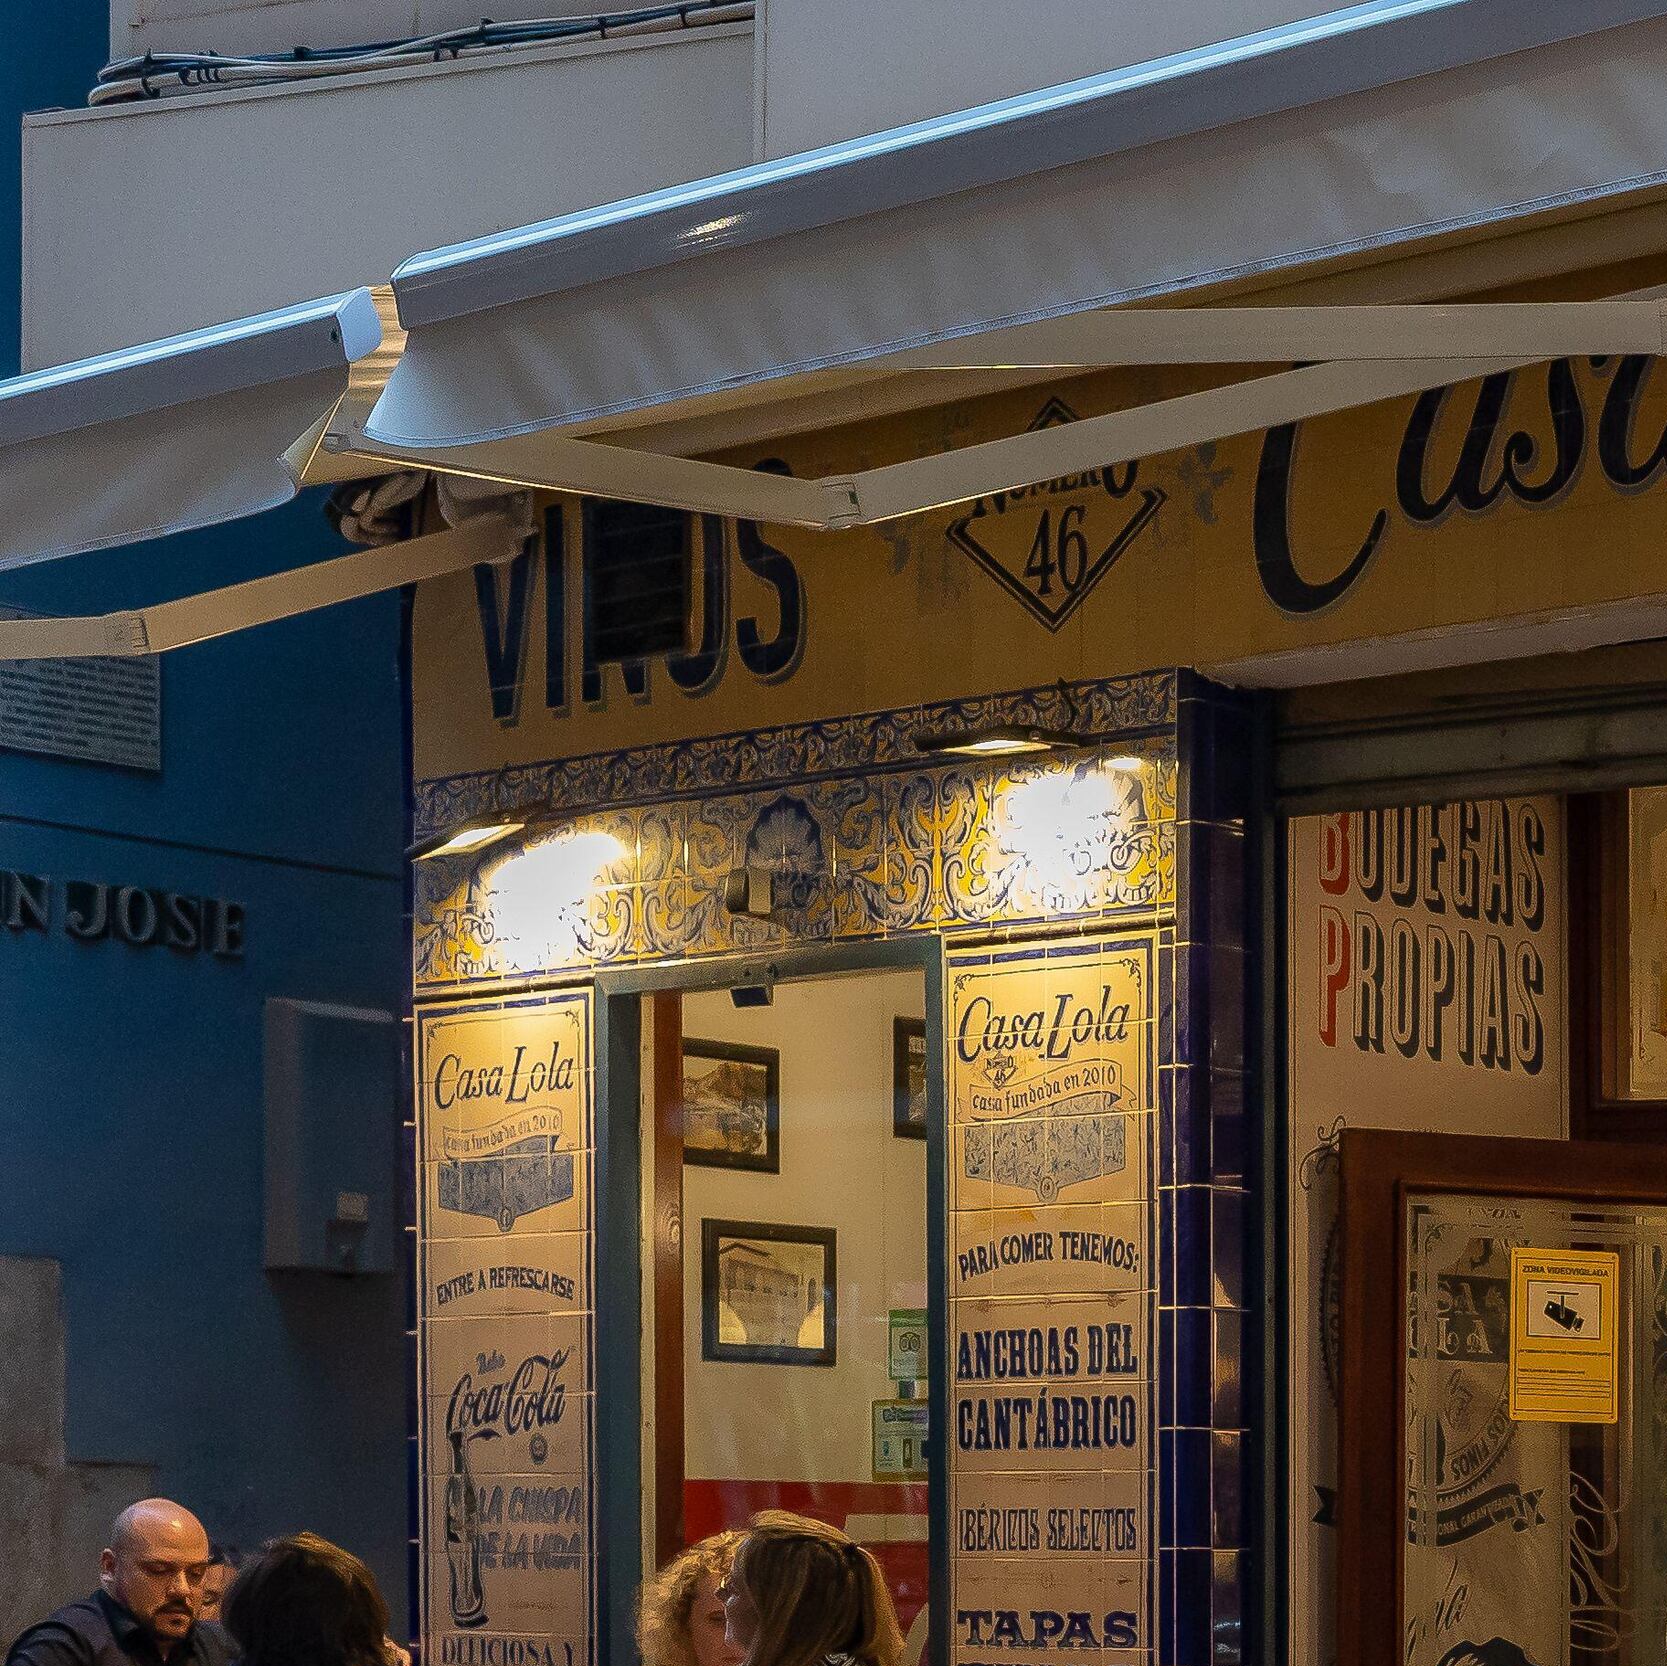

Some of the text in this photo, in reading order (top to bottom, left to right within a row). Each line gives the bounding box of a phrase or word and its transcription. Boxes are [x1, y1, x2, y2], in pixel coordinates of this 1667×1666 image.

[1023, 505, 1090, 597] 46
[65, 880, 248, 962] JOSE
[1318, 904, 1546, 1076] PROPIAS
[958, 985, 1131, 1063] Casa Lola
[434, 1041, 574, 1110] Casa Lola
[1083, 1063, 1116, 1089] 2010
[437, 1266, 575, 1305] ENTRE A REFRESCARSE
[958, 1231, 1140, 1282] PARA COMER TENEMOS:
[957, 1323, 1138, 1379] ANCHOAS DEL
[957, 1388, 1137, 1450] CANTÁBRICO
[959, 1502, 1137, 1551] IBÉRICOS SELECTOS
[957, 1609, 1138, 1649] TAPAS
